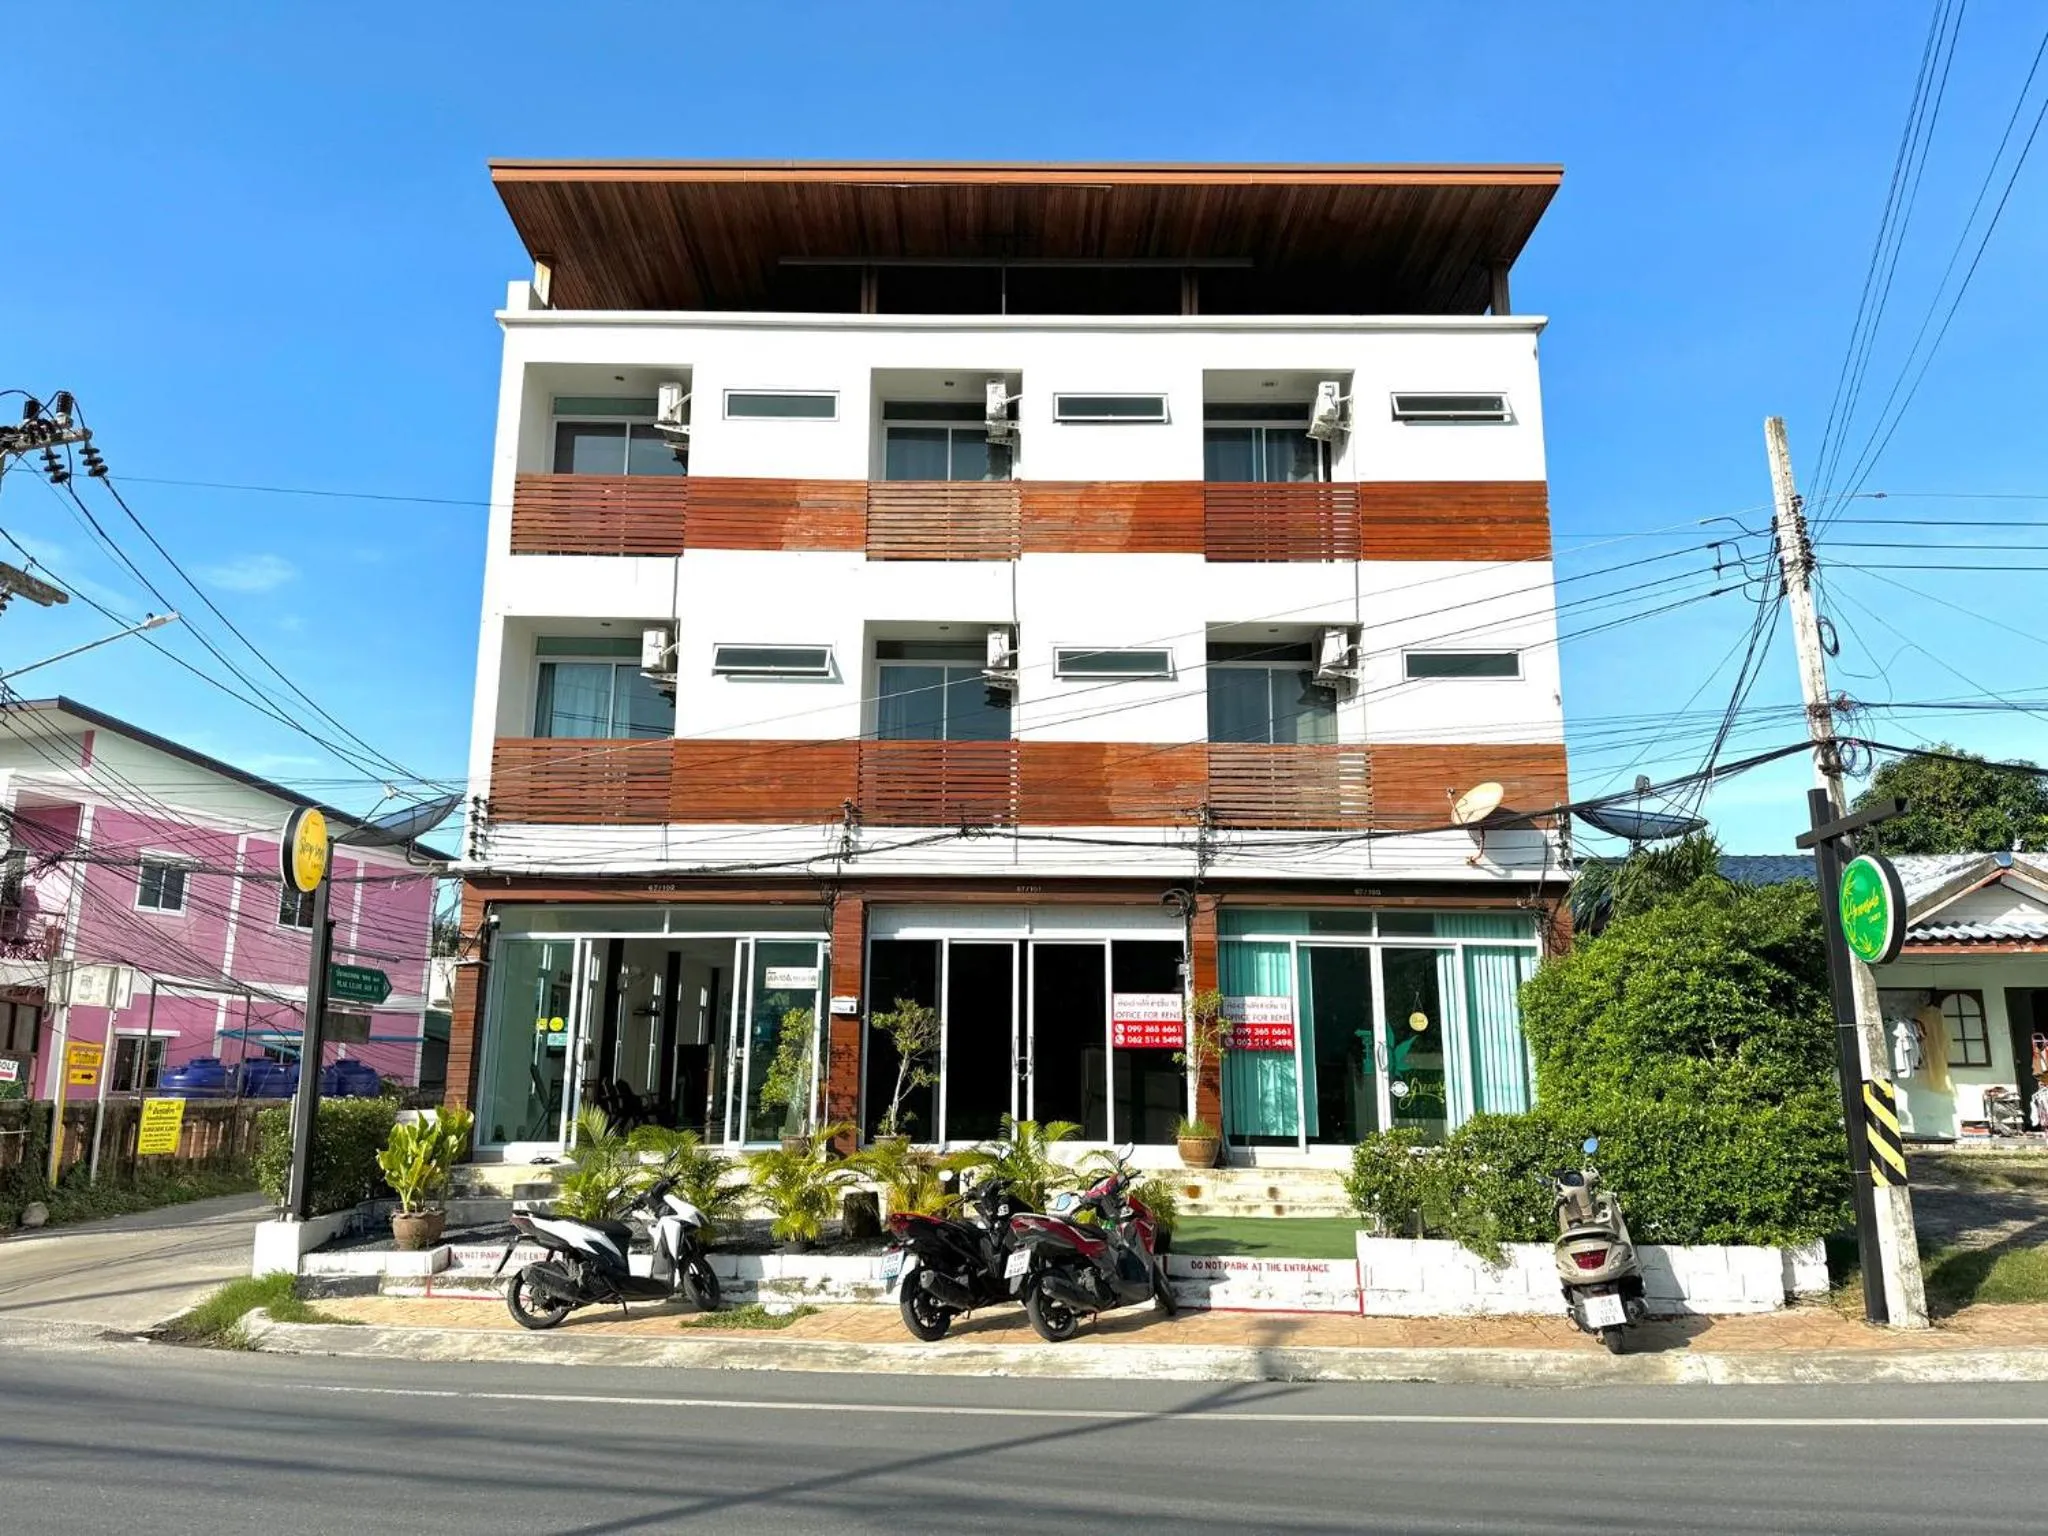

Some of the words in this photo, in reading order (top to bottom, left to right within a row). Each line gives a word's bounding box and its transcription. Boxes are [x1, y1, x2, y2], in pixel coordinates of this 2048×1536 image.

[1115, 1011, 1142, 1019] OFFICE
[1143, 1011, 1158, 1019] FOR
[1161, 1011, 1181, 1019] RENT
[1252, 1013, 1268, 1021] FOR
[1127, 1025, 1143, 1033] 099
[1162, 1025, 1182, 1033] 6661
[1254, 1027, 1270, 1036] 365
[1271, 1027, 1292, 1036] 6661
[1127, 1035, 1143, 1044] 062
[1144, 1035, 1160, 1044] 514
[0, 1061, 16, 1070] OLF
[1191, 1260, 1204, 1270] DO
[1204, 1260, 1222, 1270] NOT
[1224, 1261, 1249, 1271] PARK
[1251, 1262, 1263, 1272] AT
[1266, 1262, 1282, 1272] THE
[1284, 1263, 1330, 1273] ENTRANCE
